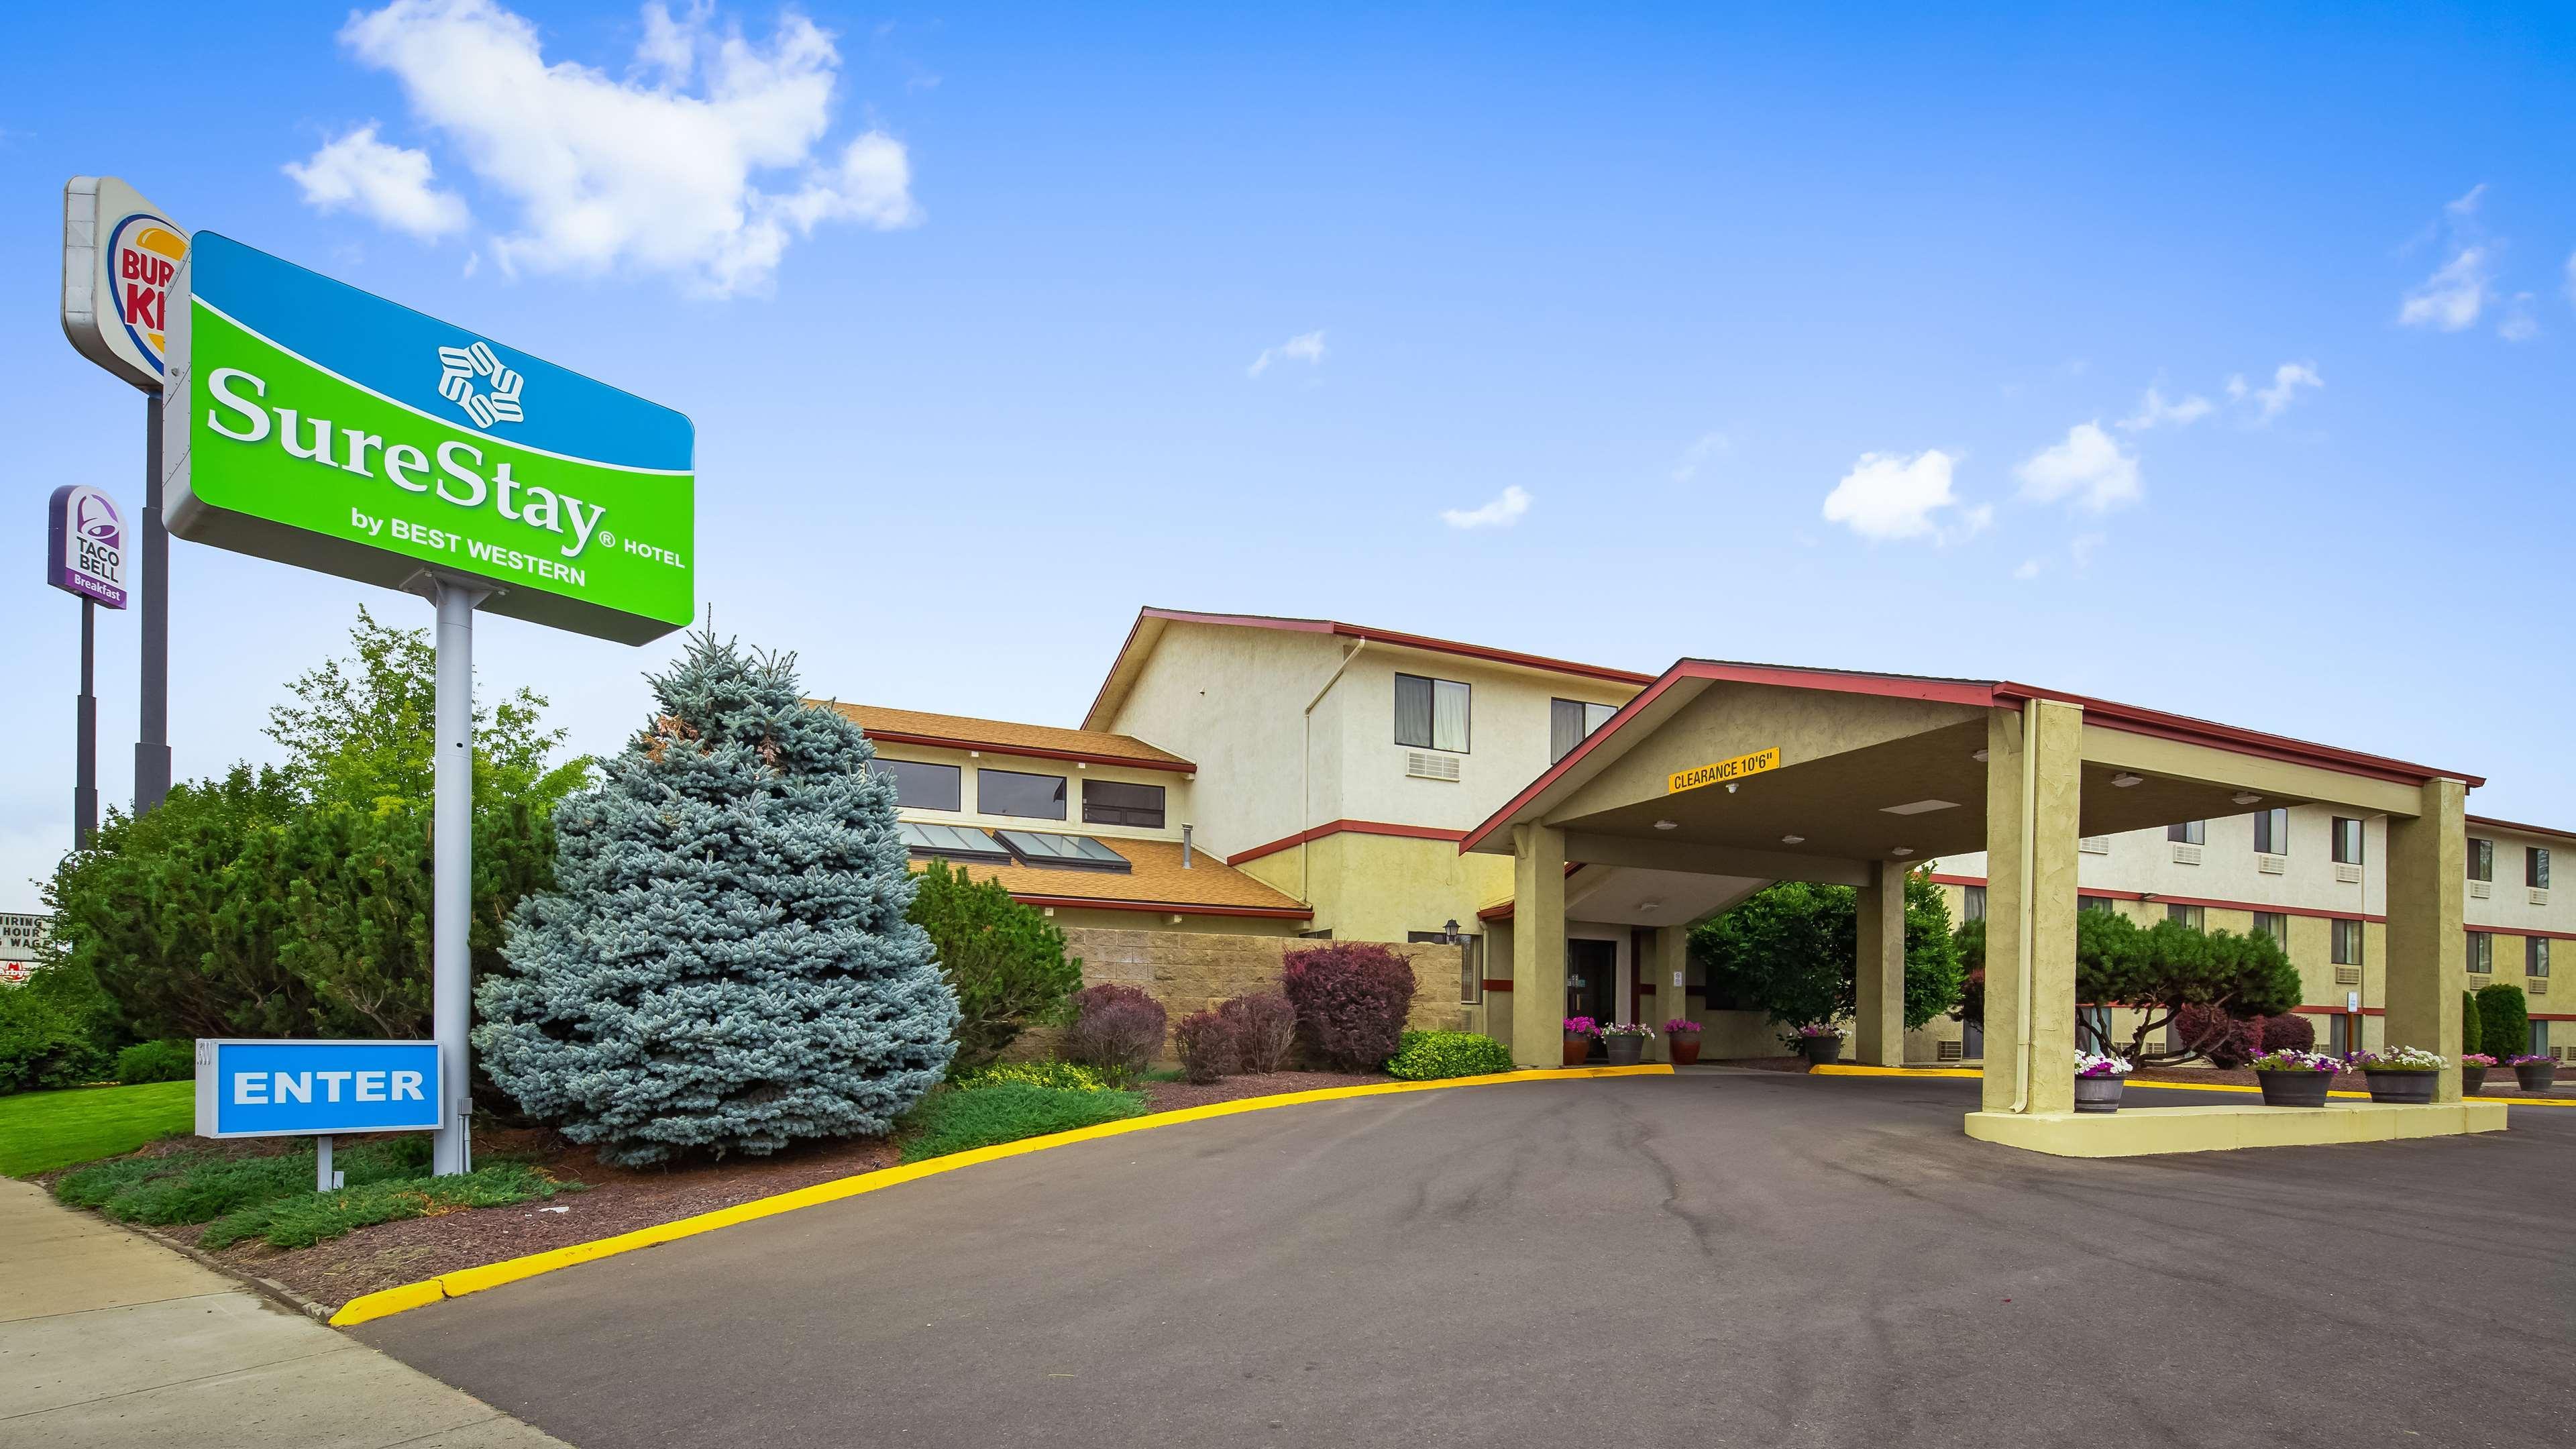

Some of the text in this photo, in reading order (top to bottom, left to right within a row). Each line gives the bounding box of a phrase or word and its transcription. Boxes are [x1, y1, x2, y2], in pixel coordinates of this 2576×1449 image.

[122, 248, 175, 287] BUR
[126, 282, 165, 331] KI
[76, 535, 119, 567] TACO
[351, 506, 586, 587] by BEST WESTERN
[625, 538, 686, 569] HOTEL
[80, 553, 119, 584] BELL
[74, 573, 121, 602] Breakfast
[1674, 752, 1772, 790] CLEARANCE 10'6"
[3, 927, 40, 937] HOUR
[11, 938, 52, 949] WAGE
[233, 1071, 425, 1105] ENTER
